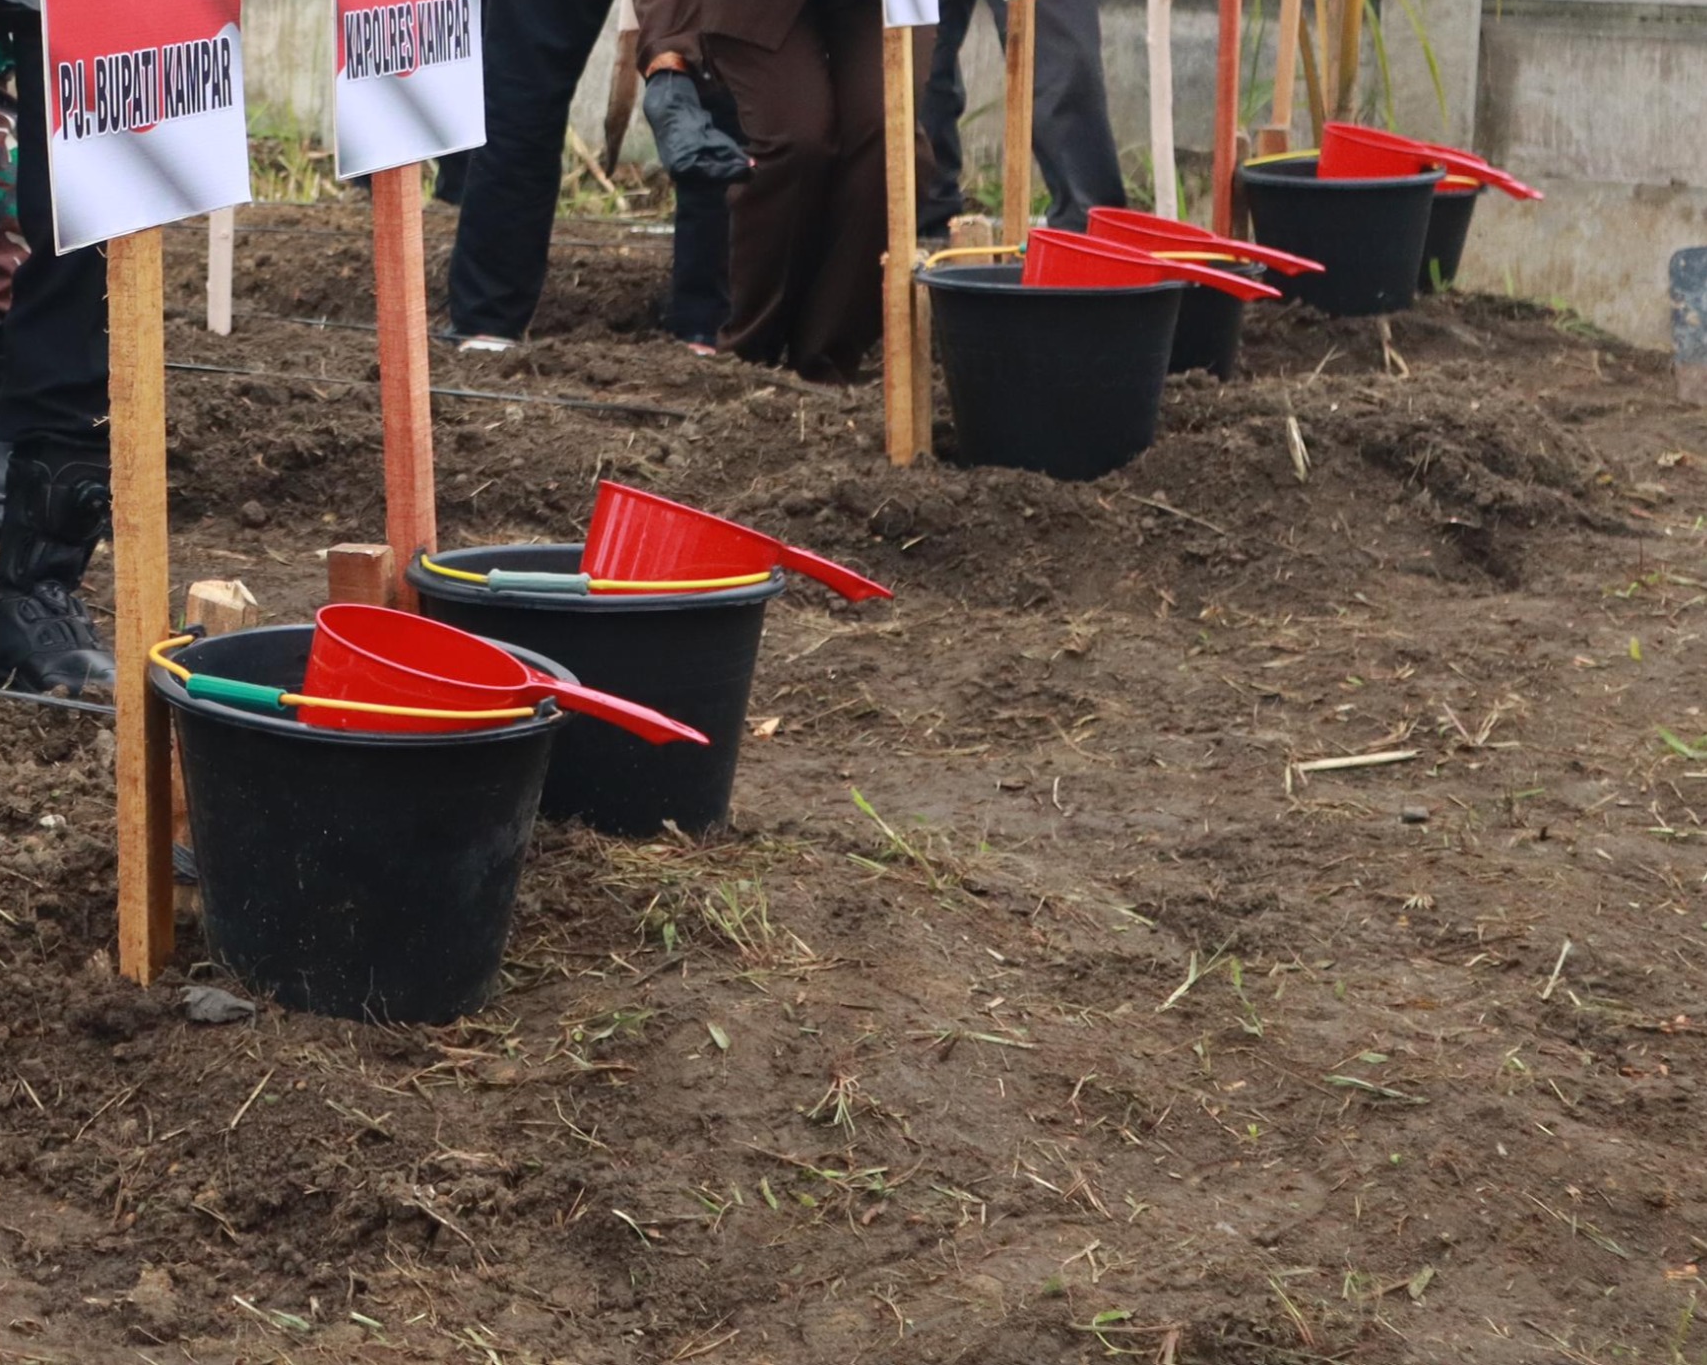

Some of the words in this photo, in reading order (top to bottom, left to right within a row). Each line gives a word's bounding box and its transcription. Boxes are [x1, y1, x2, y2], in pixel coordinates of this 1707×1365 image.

[345, 1, 414, 80] KAPOLRES
[60, 61, 91, 141] PJ.
[95, 48, 158, 134] BUPATI
[163, 37, 233, 120] KAMPAR
